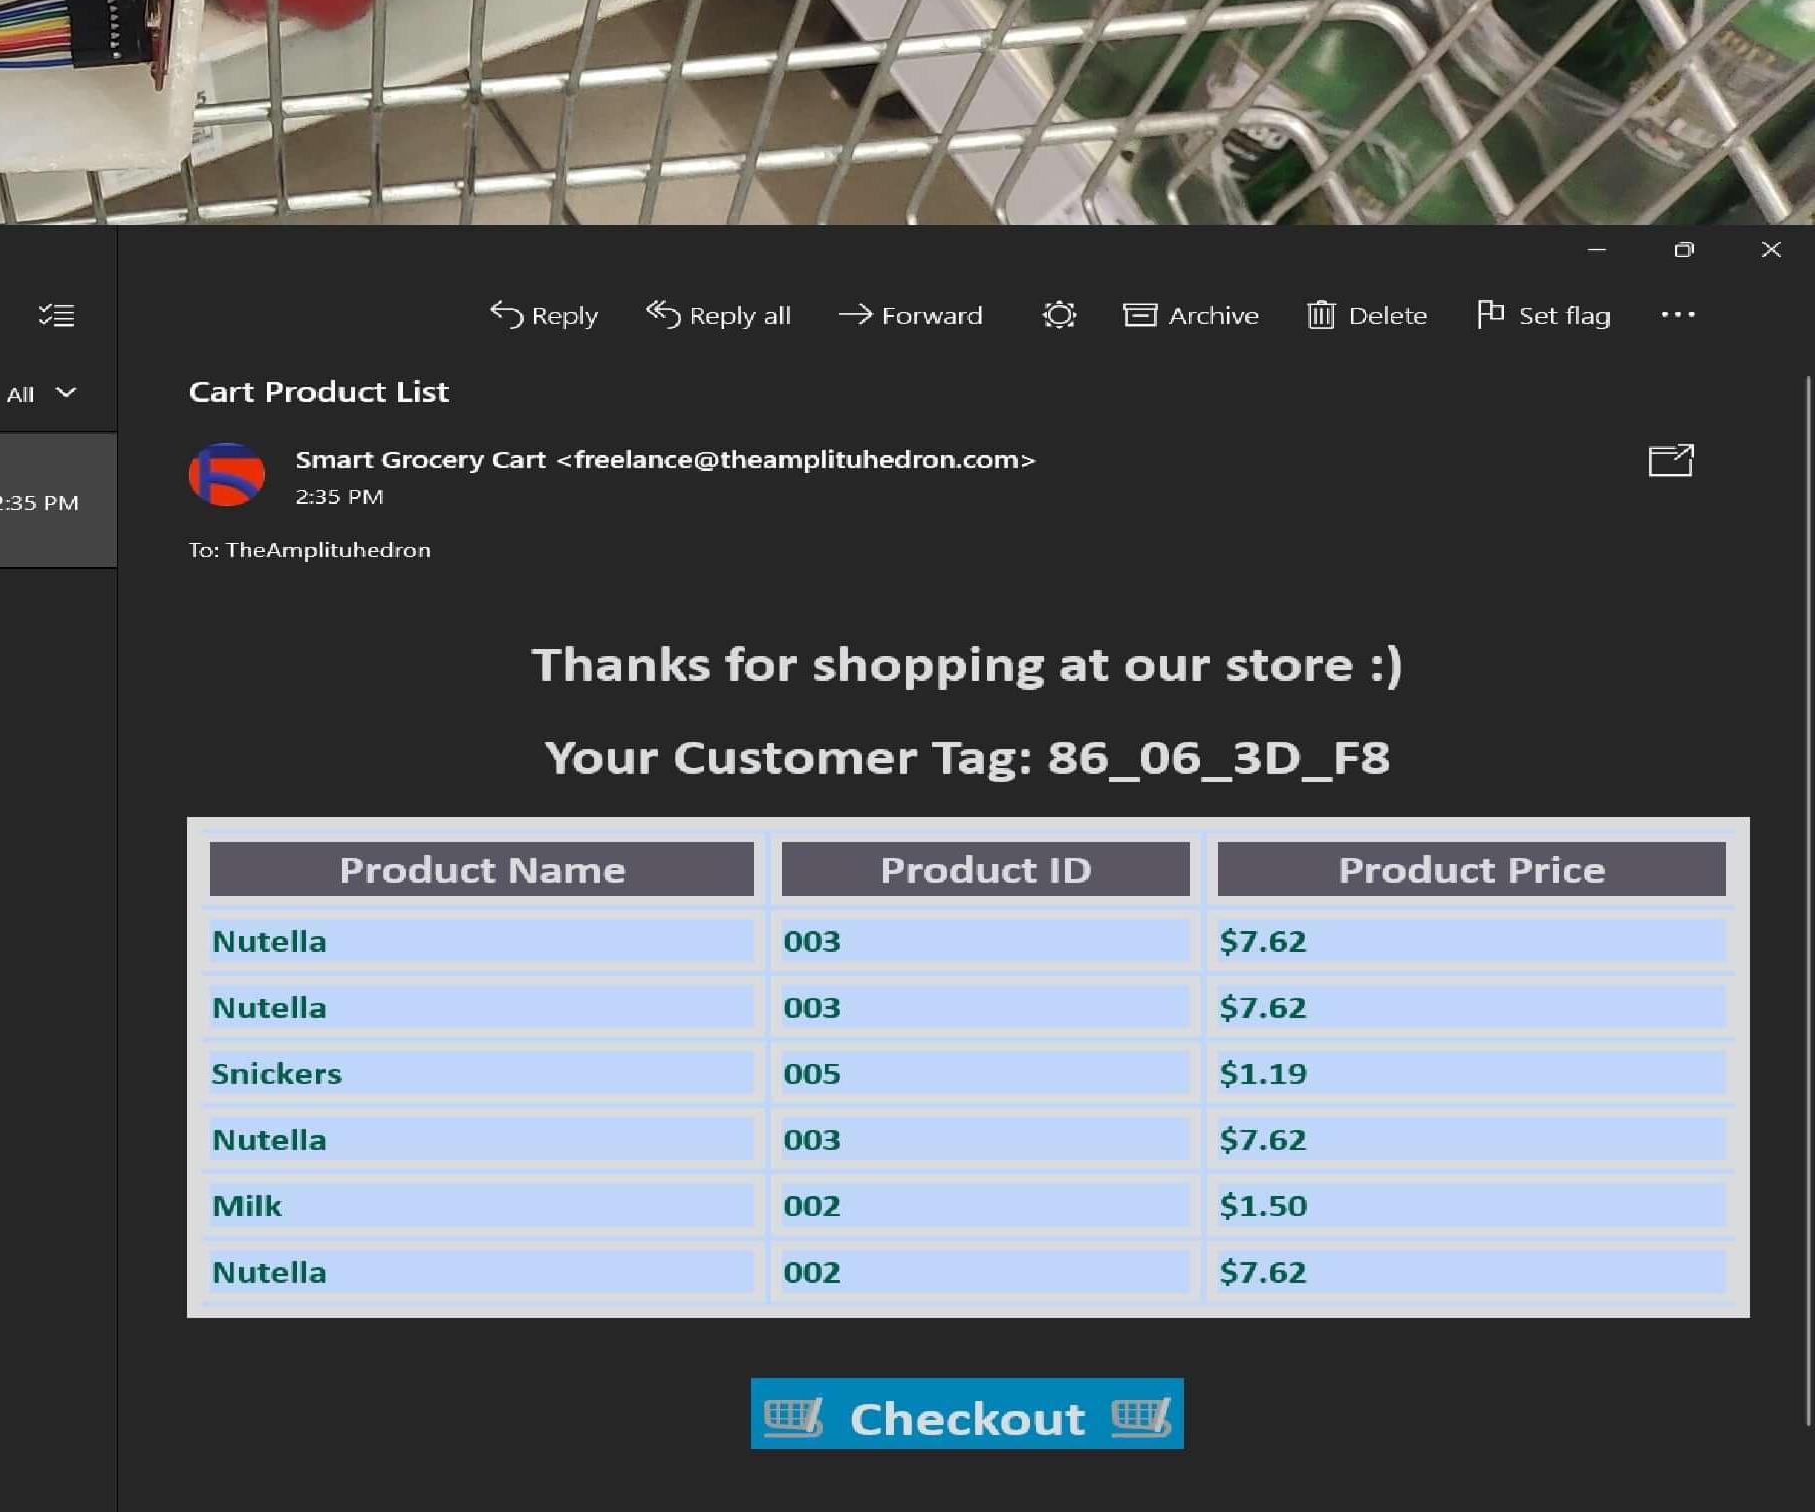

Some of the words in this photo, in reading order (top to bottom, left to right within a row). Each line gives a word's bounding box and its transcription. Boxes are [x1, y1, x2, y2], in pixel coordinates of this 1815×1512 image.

[533, 305, 599, 331] Reply
[691, 304, 757, 330] Reply
[764, 304, 791, 326] all
[883, 305, 983, 326] Forward
[1168, 304, 1260, 326] Archive
[1350, 304, 1428, 326] Delete
[1519, 307, 1559, 325] Set
[1564, 305, 1611, 330] flag
[6, 385, 34, 403] All
[189, 381, 255, 403] Cart
[266, 378, 387, 403] Product
[397, 379, 451, 403] List
[296, 451, 375, 470] Smart
[380, 451, 486, 474] Grocery
[492, 451, 547, 470] Cart
[556, 449, 1037, 474] <freelance@theamplituhedron.com>
[44, 495, 79, 512] PM
[295, 488, 341, 505] 2:35
[348, 488, 384, 505] PM
[188, 542, 219, 559] To:
[224, 540, 431, 563] TheAmplituhedron
[530, 645, 711, 682] Thanks
[724, 645, 798, 682] for
[813, 645, 1045, 691] shopping
[1059, 649, 1110, 682] at
[1124, 655, 1211, 682] our
[1226, 649, 1354, 682] store
[1371, 644, 1402, 691] :)
[543, 741, 659, 775] Your
[674, 741, 919, 776] Customer
[931, 741, 1031, 783] Tag:
[1047, 741, 1390, 783] 86_06_3D_F8
[341, 854, 497, 884] Product
[509, 857, 627, 884] Name
[882, 854, 1038, 884] Product
[1050, 857, 1092, 884] ID
[1339, 854, 1496, 884] Product
[1509, 855, 1606, 884] Price
[212, 929, 327, 953] Nutella
[784, 930, 841, 953] 003
[1220, 927, 1308, 957] $7.62
[212, 995, 327, 1019] Nutella
[784, 996, 841, 1019] 003
[1220, 993, 1308, 1023] $7.62
[212, 1061, 343, 1085] Snickers
[784, 1062, 841, 1085] 005
[1220, 1059, 1308, 1089] $1.19
[212, 1128, 327, 1151] Nutella
[784, 1129, 841, 1151] 003
[1220, 1126, 1308, 1155] $7.62
[212, 1194, 283, 1217] Milk
[784, 1195, 841, 1217] 002
[1220, 1192, 1308, 1221] $1.50
[212, 1260, 327, 1284] Nutella
[784, 1261, 841, 1284] 002
[1220, 1258, 1308, 1288] $7.62
[851, 1400, 1086, 1436] Checkout
